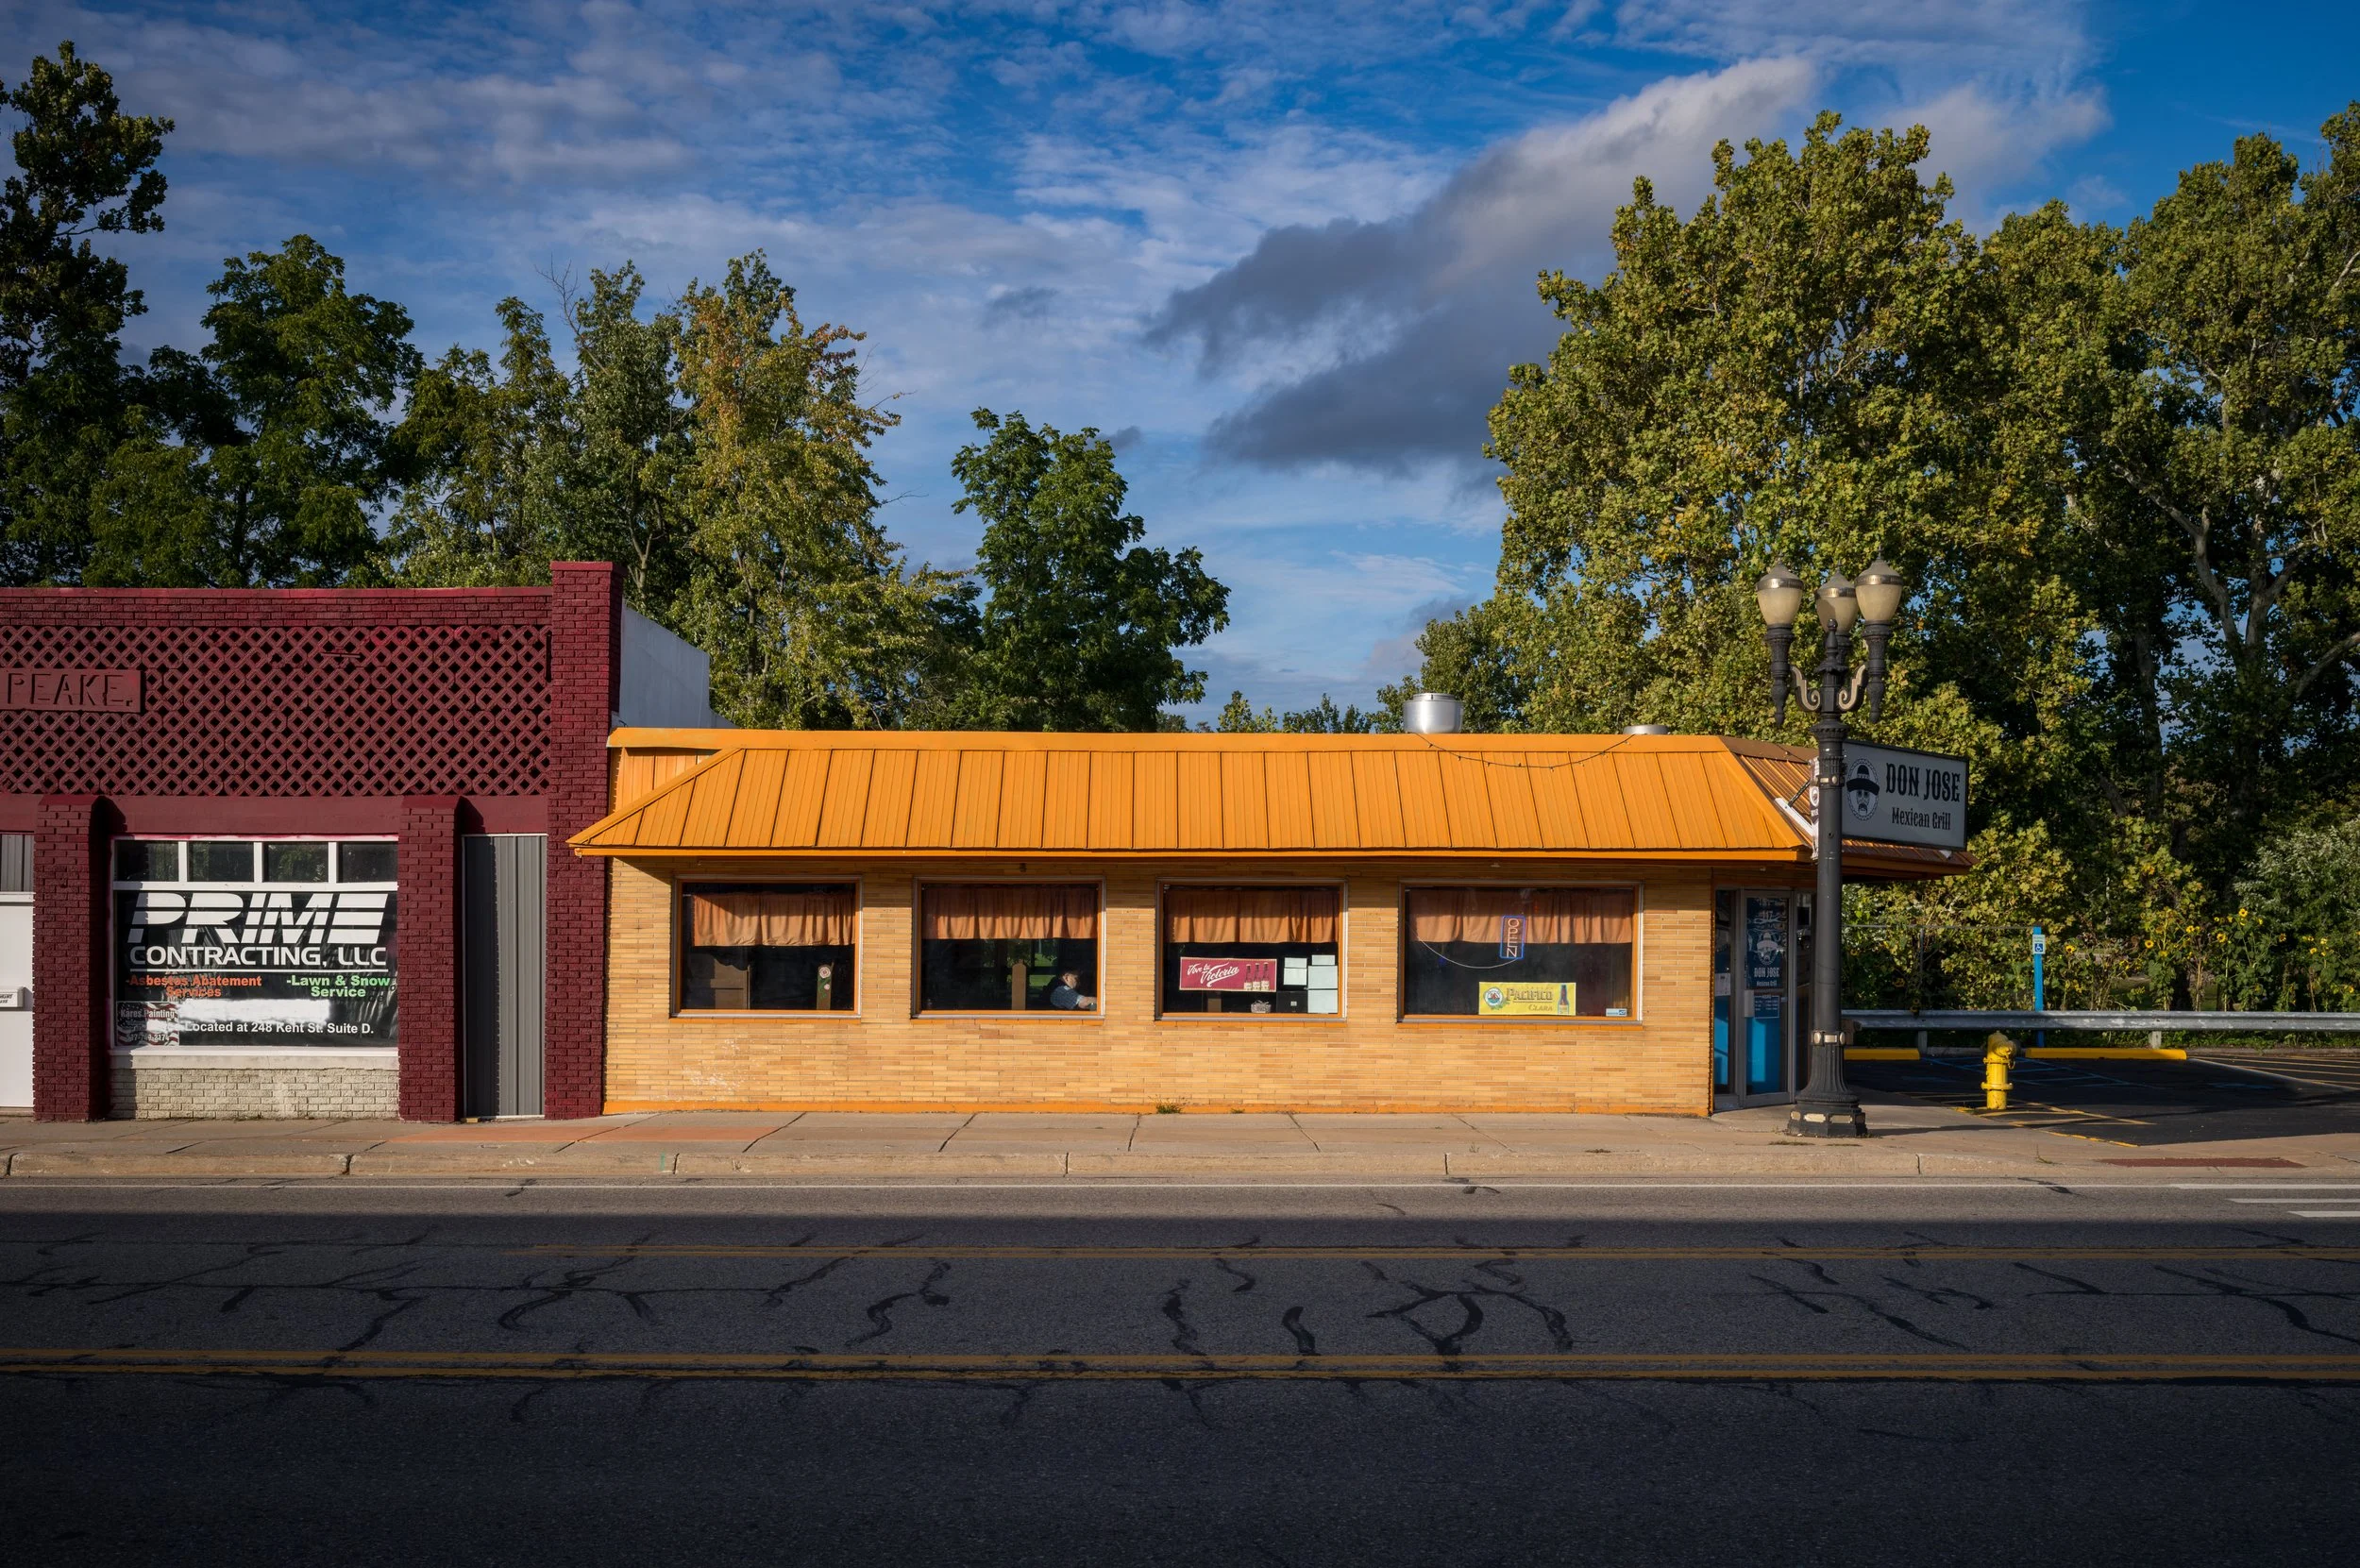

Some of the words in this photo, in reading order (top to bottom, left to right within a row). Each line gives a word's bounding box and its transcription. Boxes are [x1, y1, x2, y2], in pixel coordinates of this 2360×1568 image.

[1885, 762, 1920, 798] DON
[1923, 767, 1961, 802] JOSE
[1892, 806, 1930, 828] Mexican
[1931, 812, 1951, 831] Grill
[126, 892, 388, 944] PRIME
[1506, 918, 1520, 958] OPEN
[129, 945, 329, 968] CONTRACTING,
[338, 946, 387, 966] LLC
[193, 974, 262, 986] Abatement
[286, 974, 330, 986] -Lawn
[334, 974, 346, 986] &
[350, 974, 391, 986] Snow
[1200, 962, 1240, 987] Victoria
[165, 986, 222, 998] Services
[311, 986, 366, 998] Service
[143, 1009, 176, 1020] Painting
[185, 1020, 233, 1033] Located
[236, 1021, 248, 1033] at
[251, 1022, 273, 1034] 248
[276, 1022, 304, 1034] Kent
[307, 1022, 324, 1034] St.
[327, 1022, 359, 1035] Suite
[361, 1022, 375, 1035] D.
